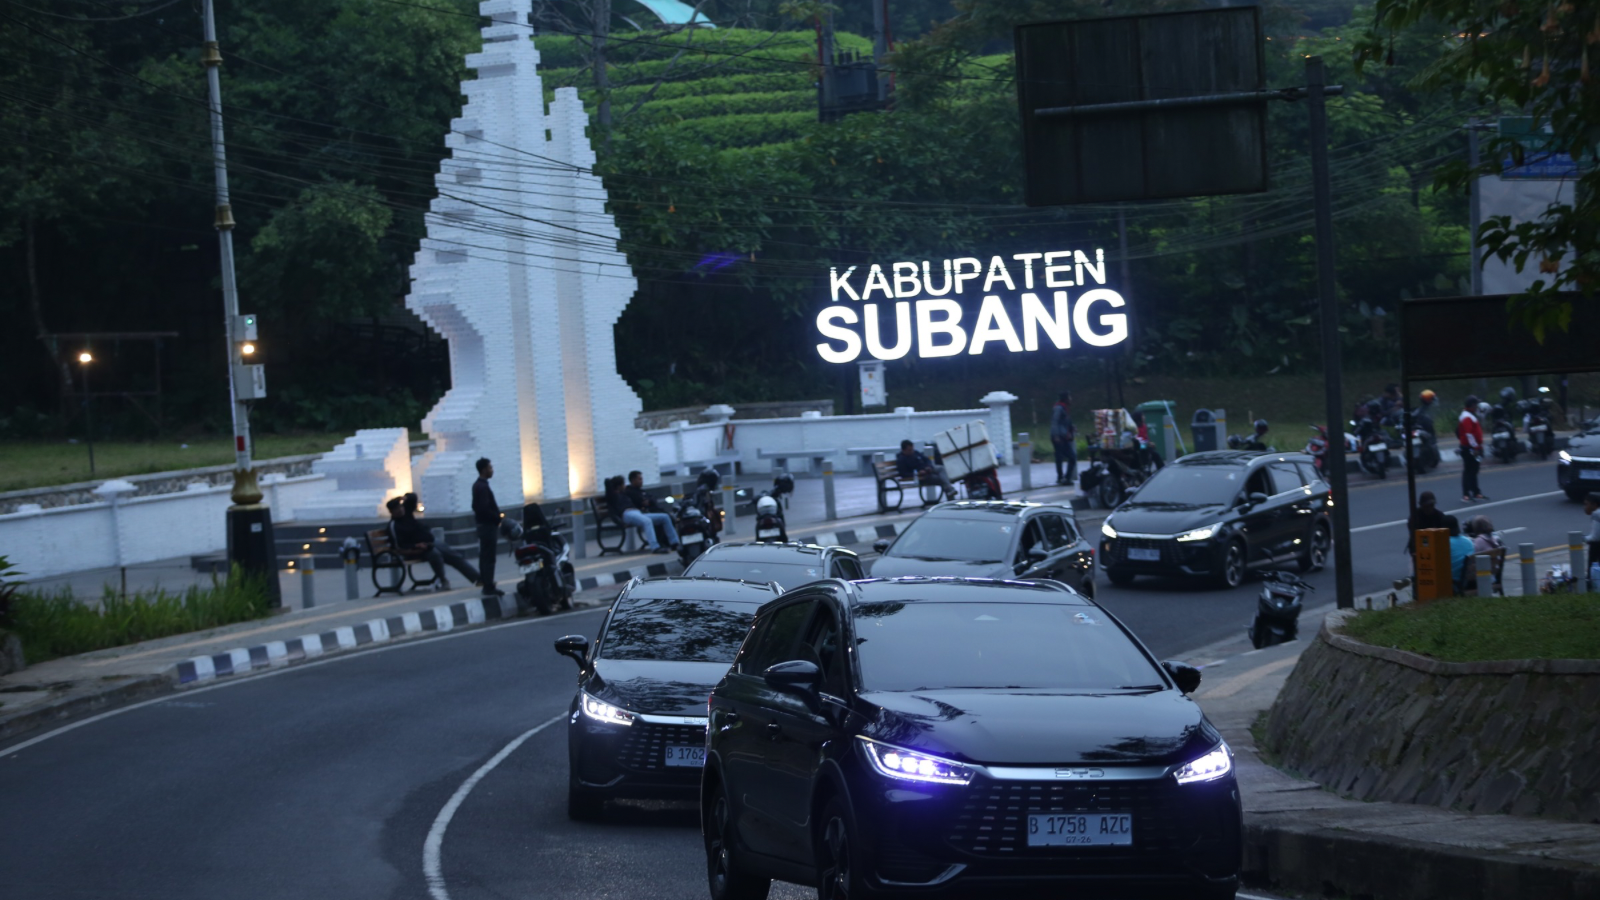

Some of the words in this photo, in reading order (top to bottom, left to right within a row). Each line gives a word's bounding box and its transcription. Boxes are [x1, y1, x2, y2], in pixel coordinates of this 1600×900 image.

[829, 248, 1106, 302] KABUPATEN
[816, 288, 1128, 364] SUBANG
[667, 748, 673, 758] B
[678, 747, 705, 760] 1762
[1054, 767, 1105, 778] BYD
[1030, 817, 1038, 834] B
[1046, 816, 1087, 835] 1758
[1099, 816, 1130, 835] AZC
